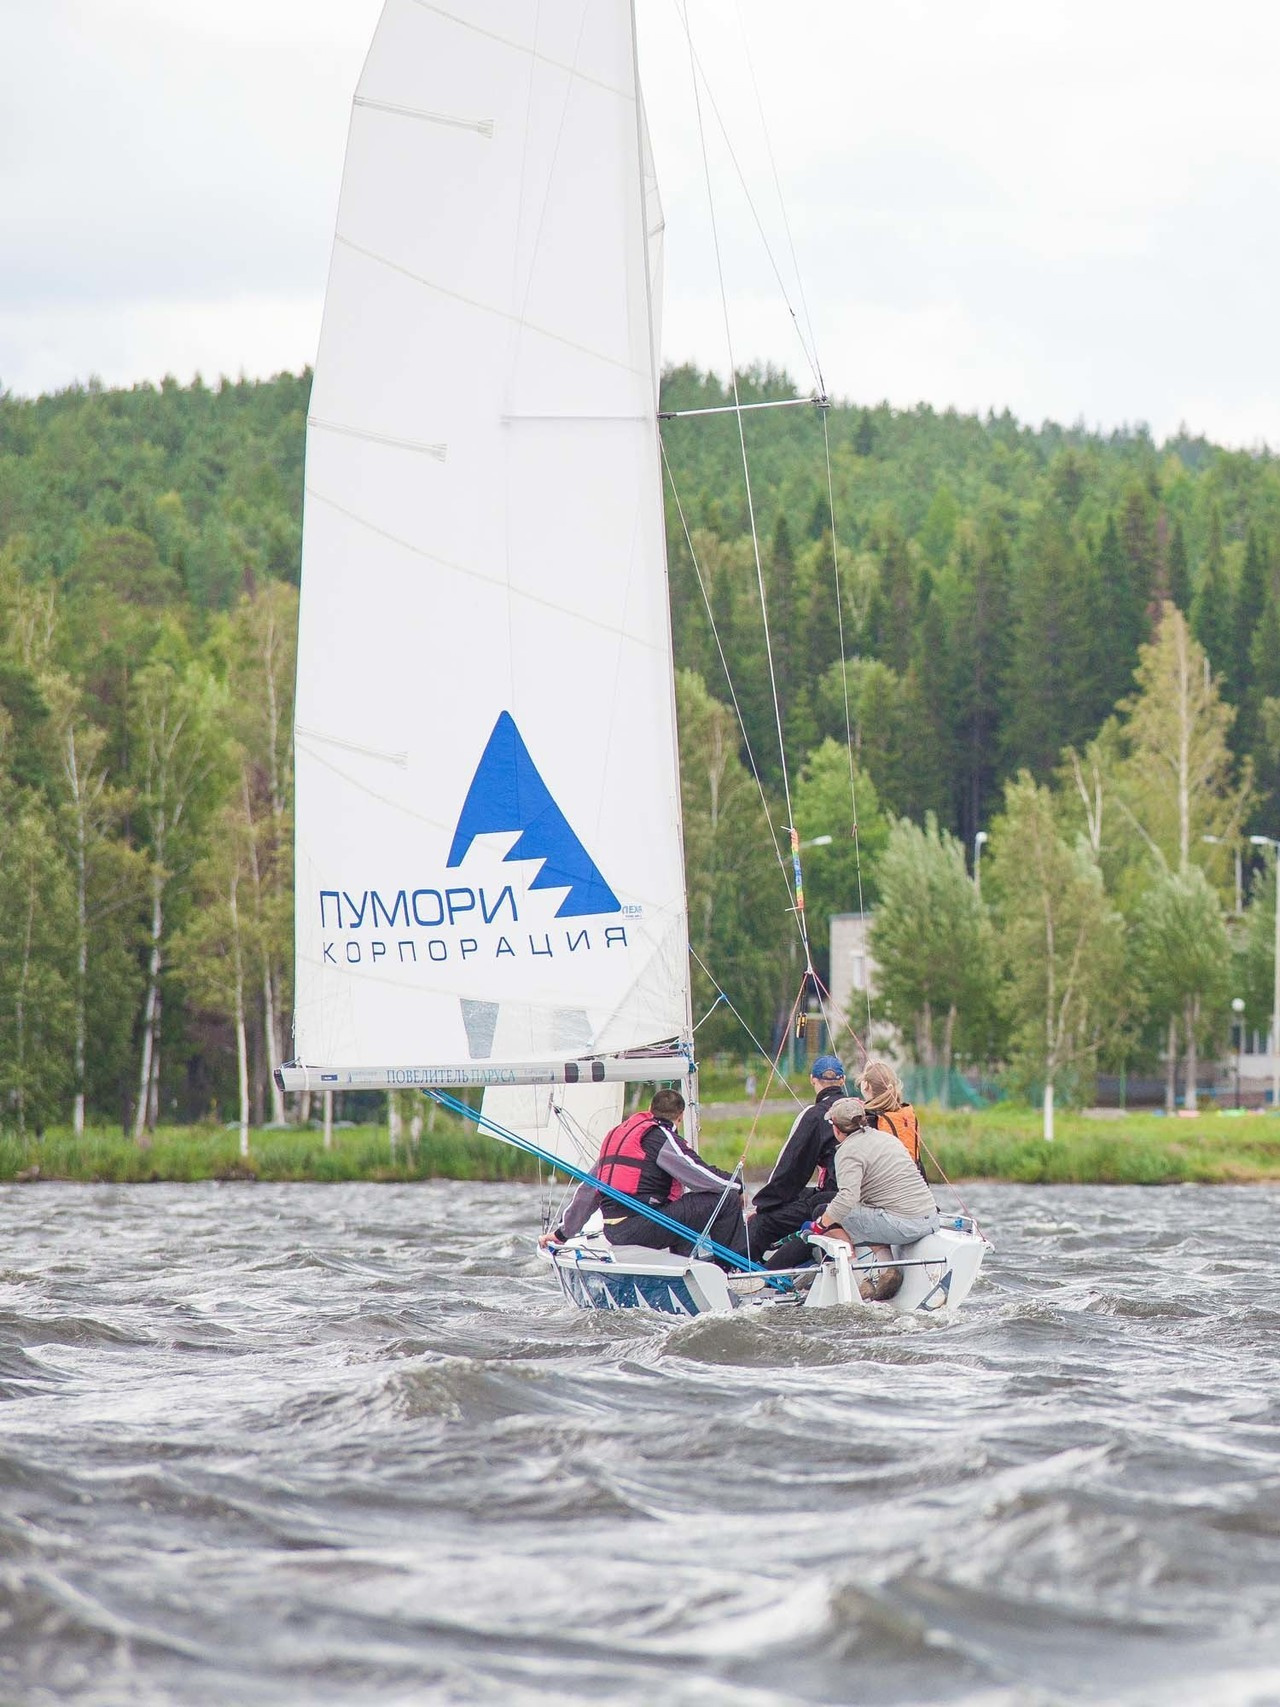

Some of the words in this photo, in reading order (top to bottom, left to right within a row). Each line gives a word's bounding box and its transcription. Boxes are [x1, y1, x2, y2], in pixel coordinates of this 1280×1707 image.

[319, 885, 519, 930] ПУМОРИ
[322, 926, 628, 964] КОРПОРАЦИЯ
[386, 1067, 469, 1084] ПОВЕЛИТЕЛЬ
[469, 1066, 516, 1083] ПАРУСА
